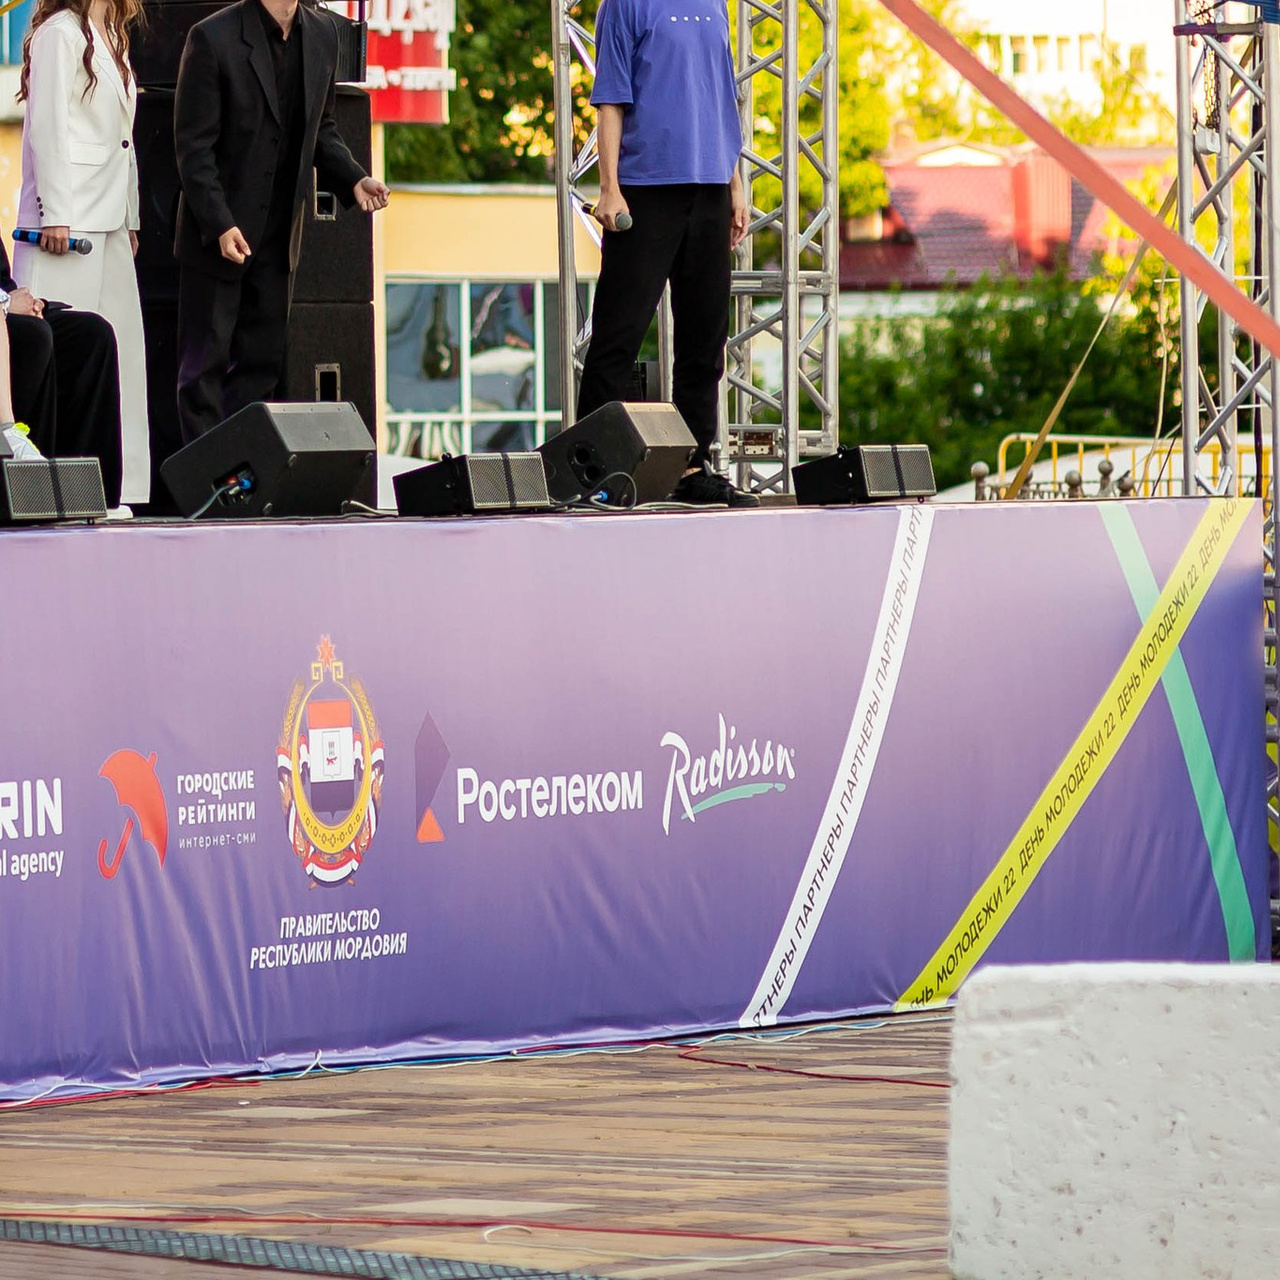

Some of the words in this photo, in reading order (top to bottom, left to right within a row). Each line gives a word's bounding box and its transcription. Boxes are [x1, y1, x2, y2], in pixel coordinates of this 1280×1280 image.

[794, 813, 845, 940] ПАРТНЕРЫ
[839, 689, 881, 815] ПАРТНЕРЫ
[874, 568, 910, 692] ПАРТНЕРЫ
[936, 885, 1004, 991] МОЛОДЕЖИ
[1003, 867, 1017, 896] 22
[1019, 825, 1045, 876] ДЕНЬ
[1045, 730, 1104, 831] МОЛОДЕЖИ
[1103, 712, 1116, 740] 22
[1117, 672, 1141, 720] ДЕНЬ
[1140, 583, 1188, 678] МОЛОДЕЖИ
[1187, 564, 1200, 590] 22
[1198, 525, 1221, 573] ДЕНЬ
[176, 769, 256, 801] ГОРОДСКИЕ
[659, 713, 796, 836] Radisson
[178, 798, 257, 826] РЕЙТИНГИ
[457, 766, 644, 824] Ростелеком
[178, 831, 257, 850] интернет-сми
[10, 850, 64, 880] agency
[279, 907, 380, 939] ПРАВИТЕЛЬСТВО
[250, 940, 332, 971] РЕСПУБЛИКИ
[333, 932, 407, 961] МОРДОВИЯ
